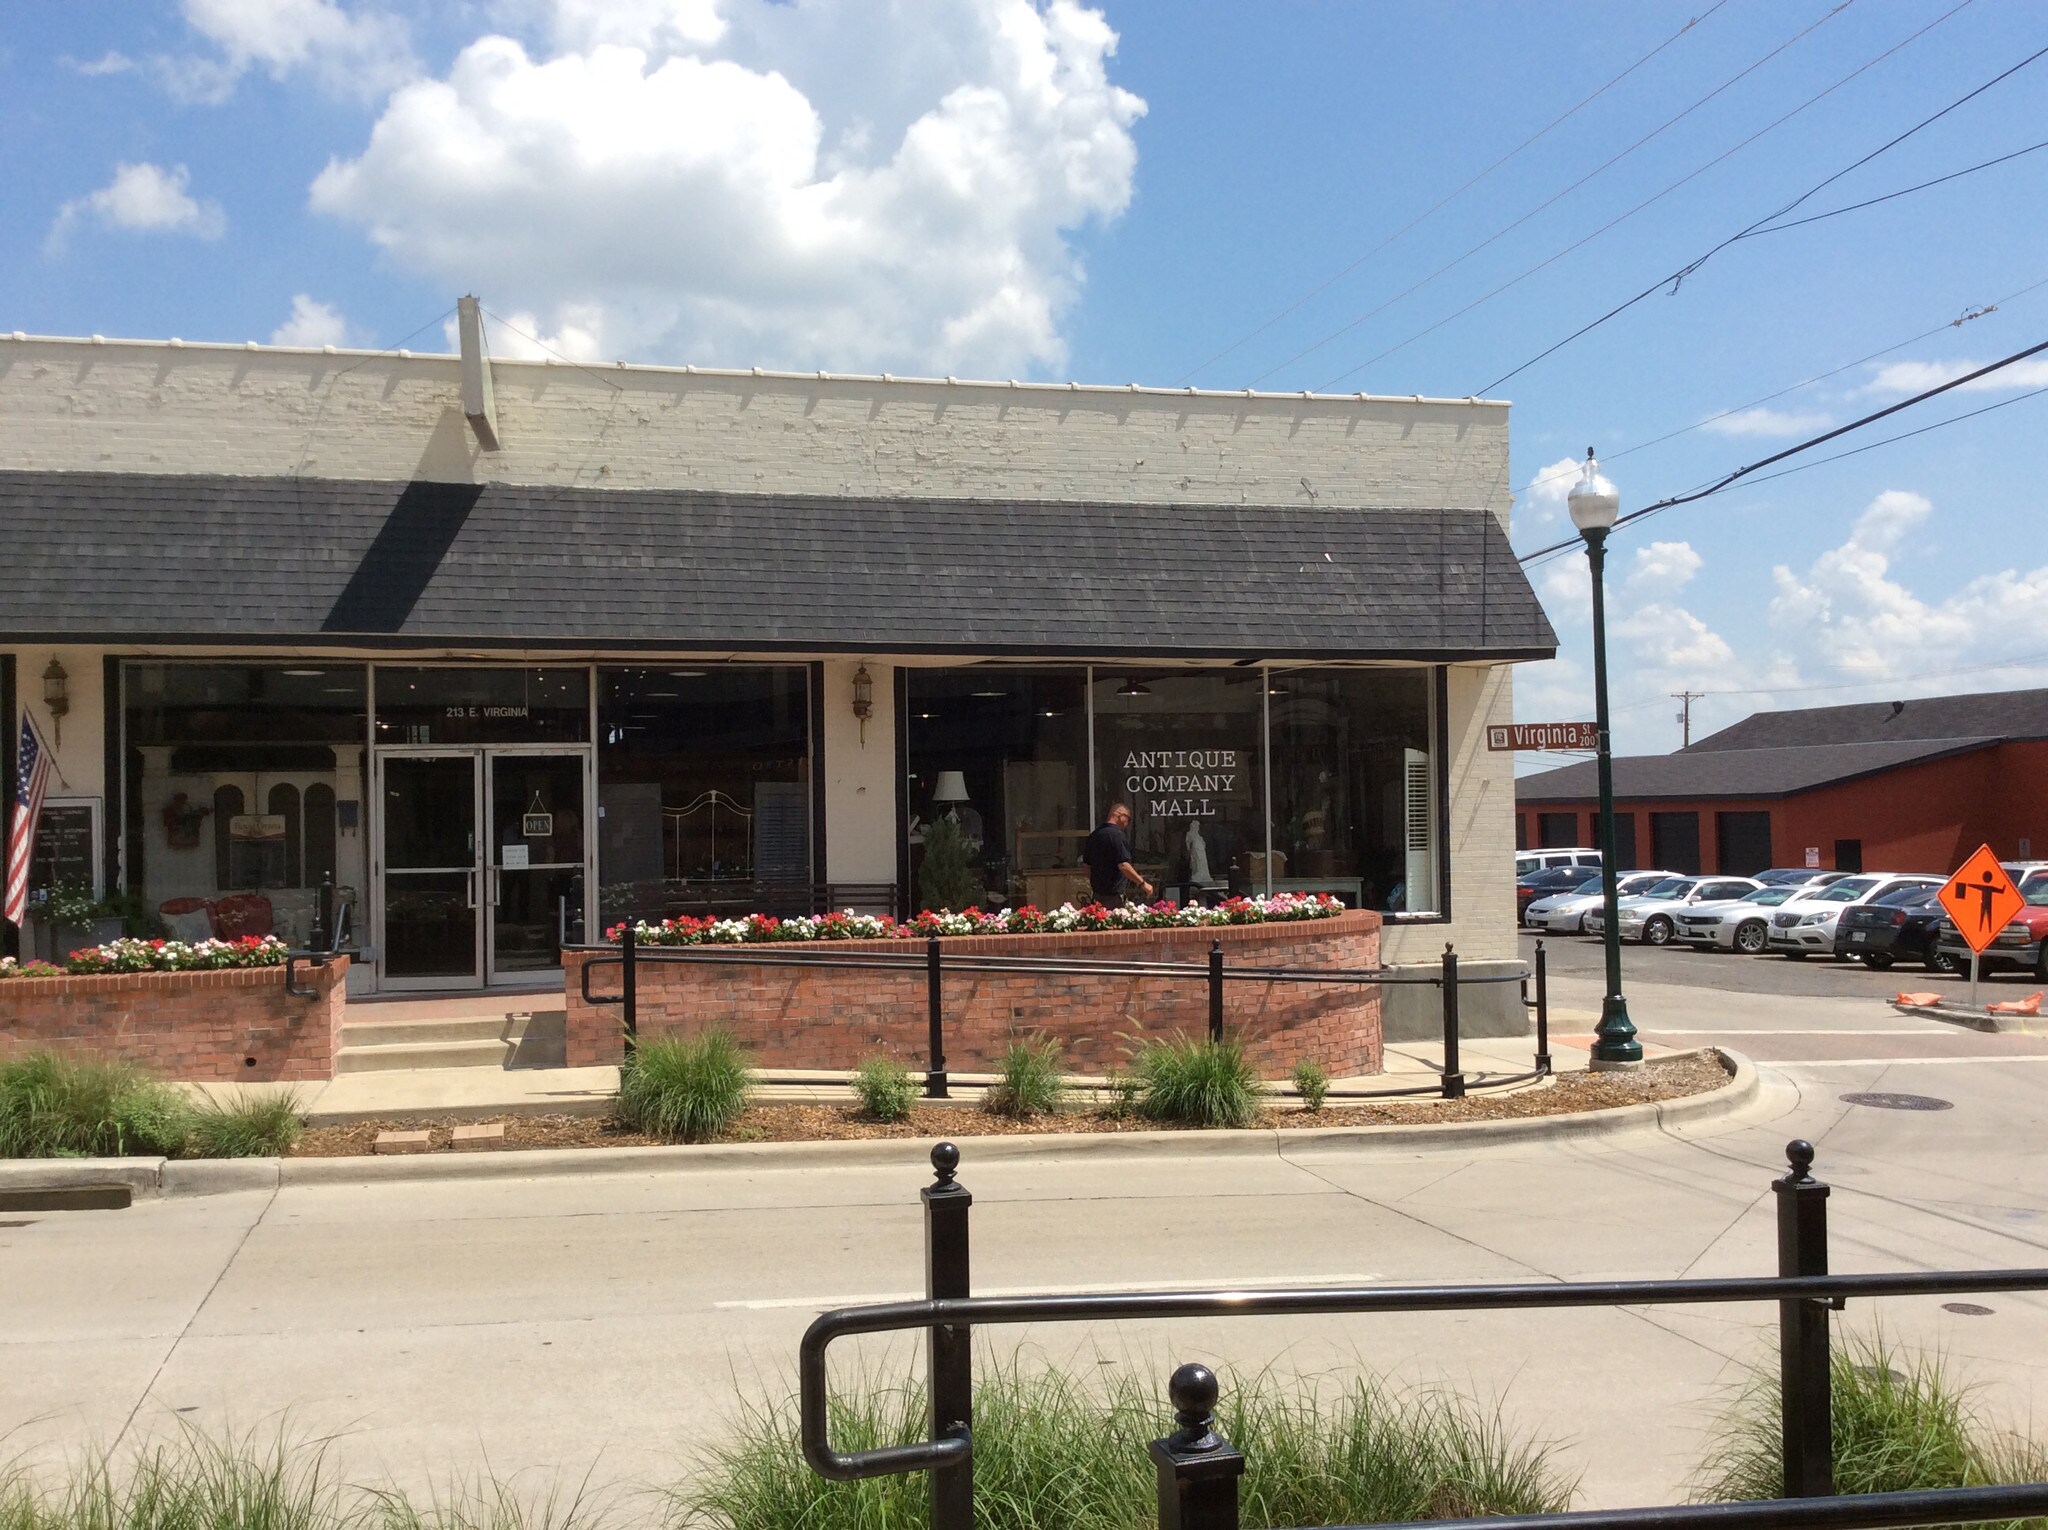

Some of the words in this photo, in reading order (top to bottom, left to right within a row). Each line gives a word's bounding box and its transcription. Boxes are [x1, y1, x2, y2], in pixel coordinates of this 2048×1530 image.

[446, 707, 464, 718] 213
[469, 707, 479, 718] E.
[483, 707, 528, 718] VIRGINIA
[1514, 724, 1577, 749] Virginia
[1582, 724, 1591, 735] St
[1580, 736, 1595, 746] 200
[1123, 750, 1236, 769] ANTIQUE
[1126, 775, 1236, 793] COMPANY
[1150, 799, 1216, 817] MALL
[526, 820, 550, 831] OPEN
